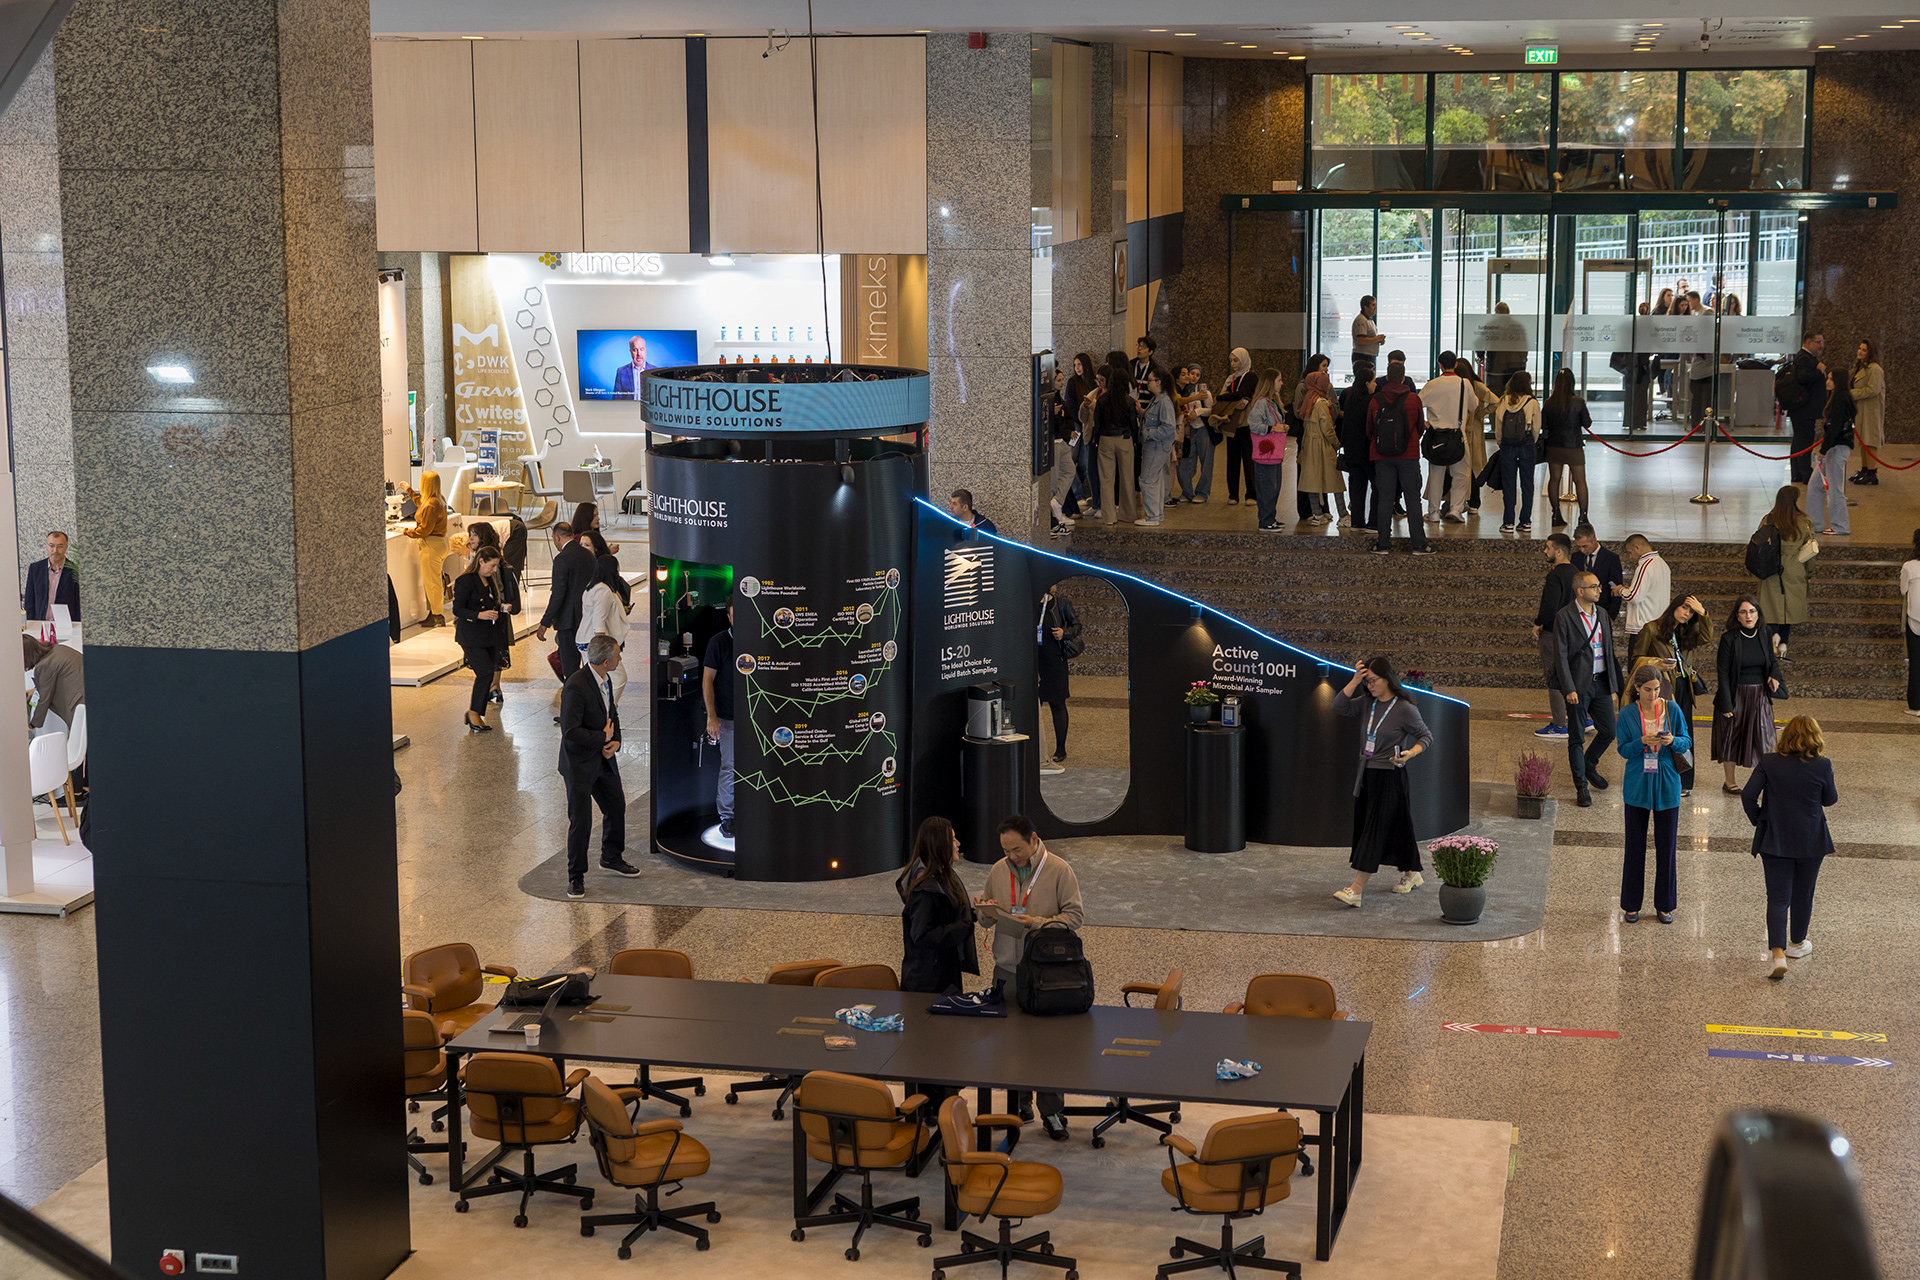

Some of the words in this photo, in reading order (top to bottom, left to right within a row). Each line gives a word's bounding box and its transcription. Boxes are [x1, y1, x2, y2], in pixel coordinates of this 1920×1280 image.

[1529, 50, 1554, 62] EXIT
[571, 252, 660, 272] kimeks
[862, 257, 887, 358] kimeks
[478, 356, 509, 367] DWK
[456, 382, 521, 398] GRAM
[648, 383, 782, 412] LIGHTHOUSE
[475, 405, 526, 424] witeg
[706, 416, 782, 427] SOLUTIONS
[653, 493, 728, 518] LIGHTHOUSE
[653, 511, 682, 524] WORLDWIDE
[685, 517, 728, 528] SOLUTIONS
[944, 609, 995, 625] LIGHTHOUSE
[944, 623, 968, 631] WORLDWIDE
[969, 620, 995, 628] SOLUTIONS
[941, 645, 970, 661] LS-20
[1212, 644, 1259, 660] Active
[941, 663, 950, 671] The
[951, 661, 963, 669] Ideal
[964, 659, 982, 668] Choice
[983, 657, 992, 665] for
[1212, 659, 1296, 678] Count100H
[941, 671, 956, 680] Liquid
[957, 669, 971, 677] Batch
[972, 666, 997, 675] Sampling
[1213, 674, 1263, 685] Award-Winning
[1213, 683, 1243, 691] Microbial
[1256, 686, 1283, 695] Sampler
